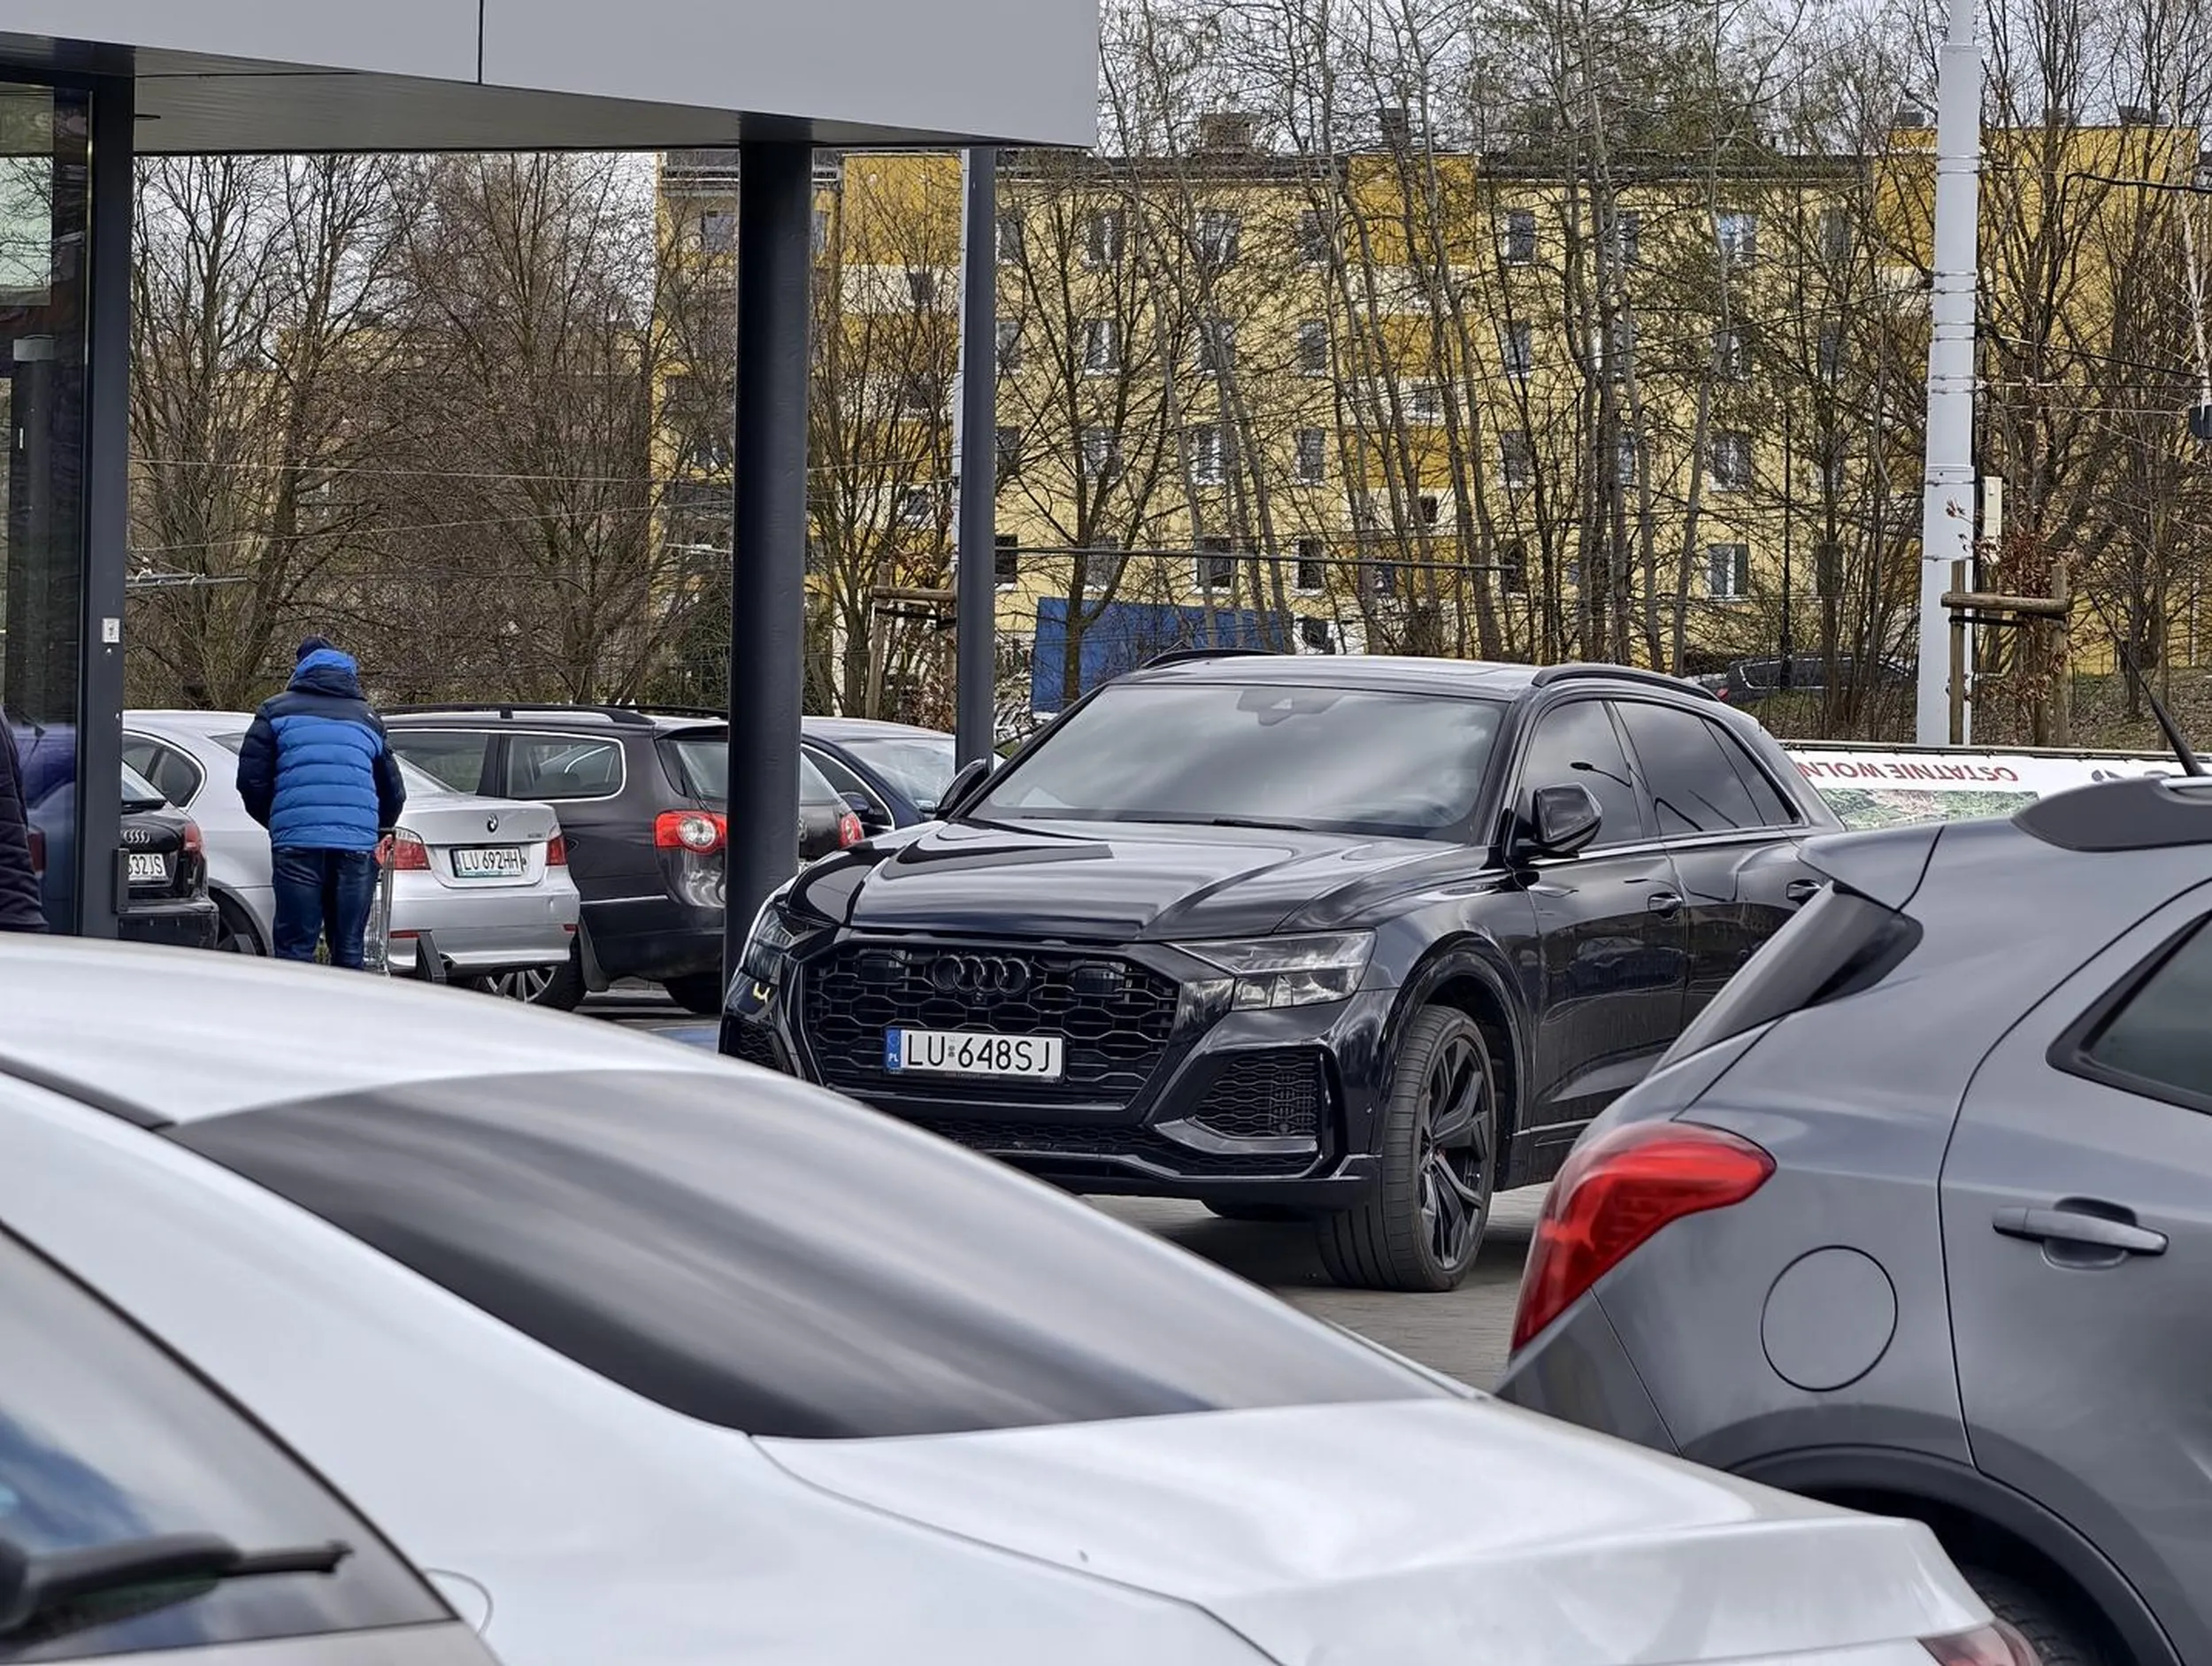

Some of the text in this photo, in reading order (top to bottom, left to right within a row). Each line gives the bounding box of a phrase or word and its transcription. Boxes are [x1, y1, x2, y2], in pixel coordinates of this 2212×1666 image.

[1884, 763, 2019, 781] OSTATNIE
[462, 849, 518, 871] LU 692HH
[908, 1033, 1050, 1073] LU 648SJ
